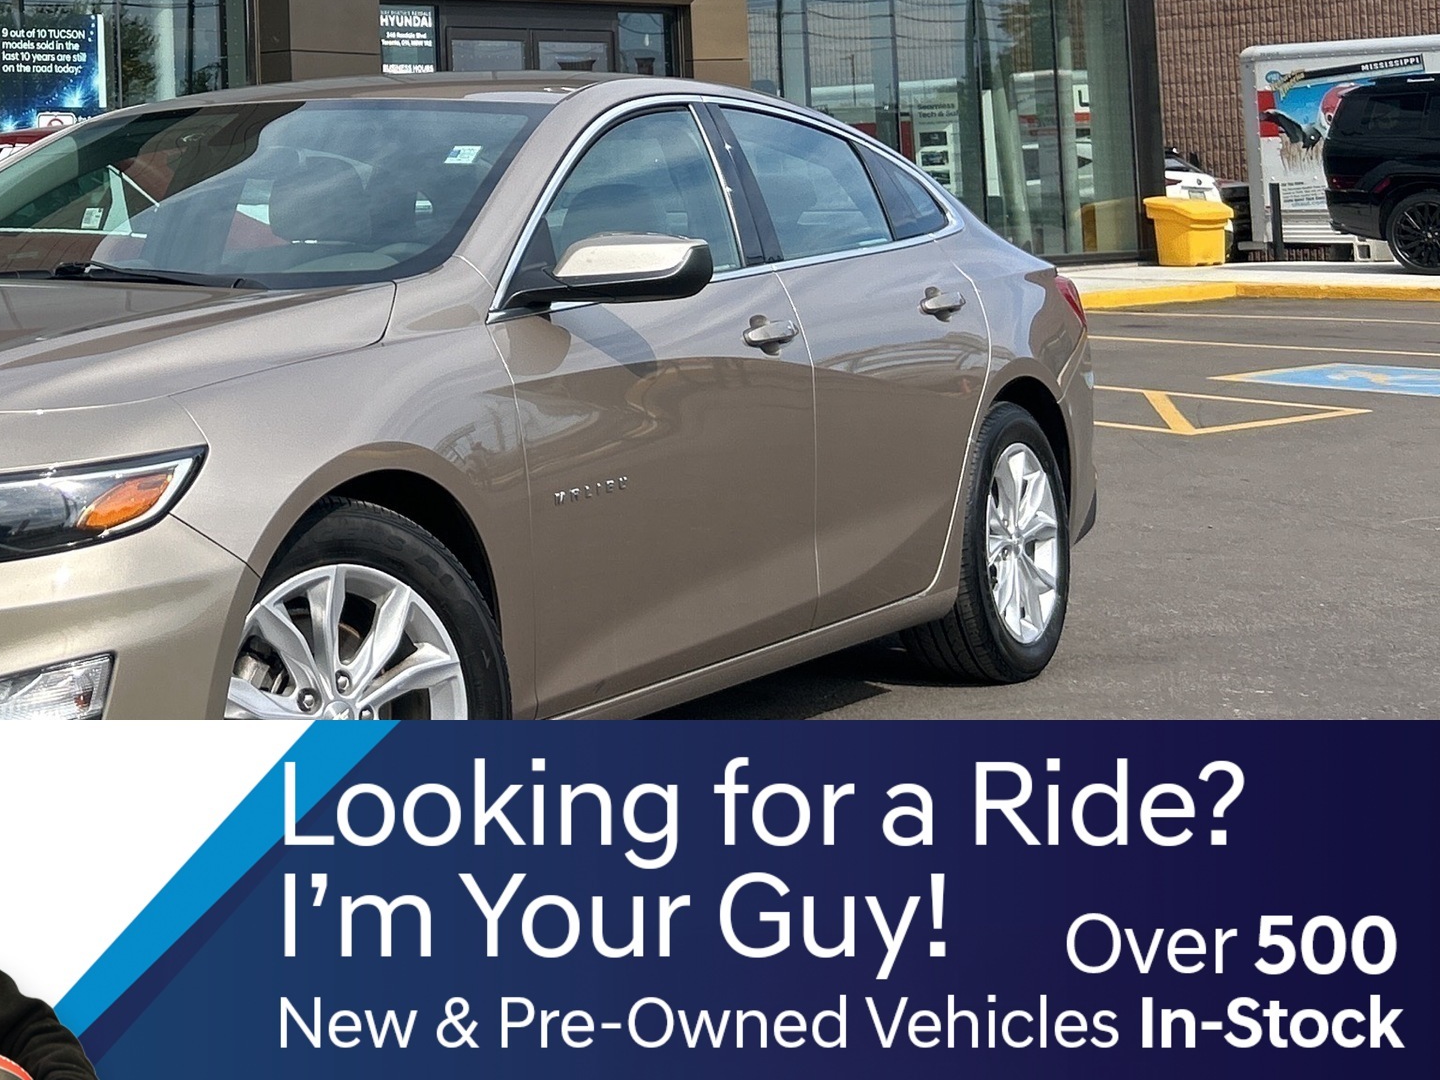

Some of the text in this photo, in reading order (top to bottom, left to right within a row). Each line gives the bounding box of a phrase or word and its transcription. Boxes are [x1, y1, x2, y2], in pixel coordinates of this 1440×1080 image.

[380, 15, 432, 27] HYUNDAI
[1, 28, 86, 40] 9 out of 10 TUCSON
[1, 39, 80, 50] models sold in the
[1, 51, 87, 63] last 10 years are still
[2, 64, 15, 73] on
[16, 63, 31, 73] the
[32, 63, 53, 73] road
[1361, 56, 1420, 71] MISSISSIPPI
